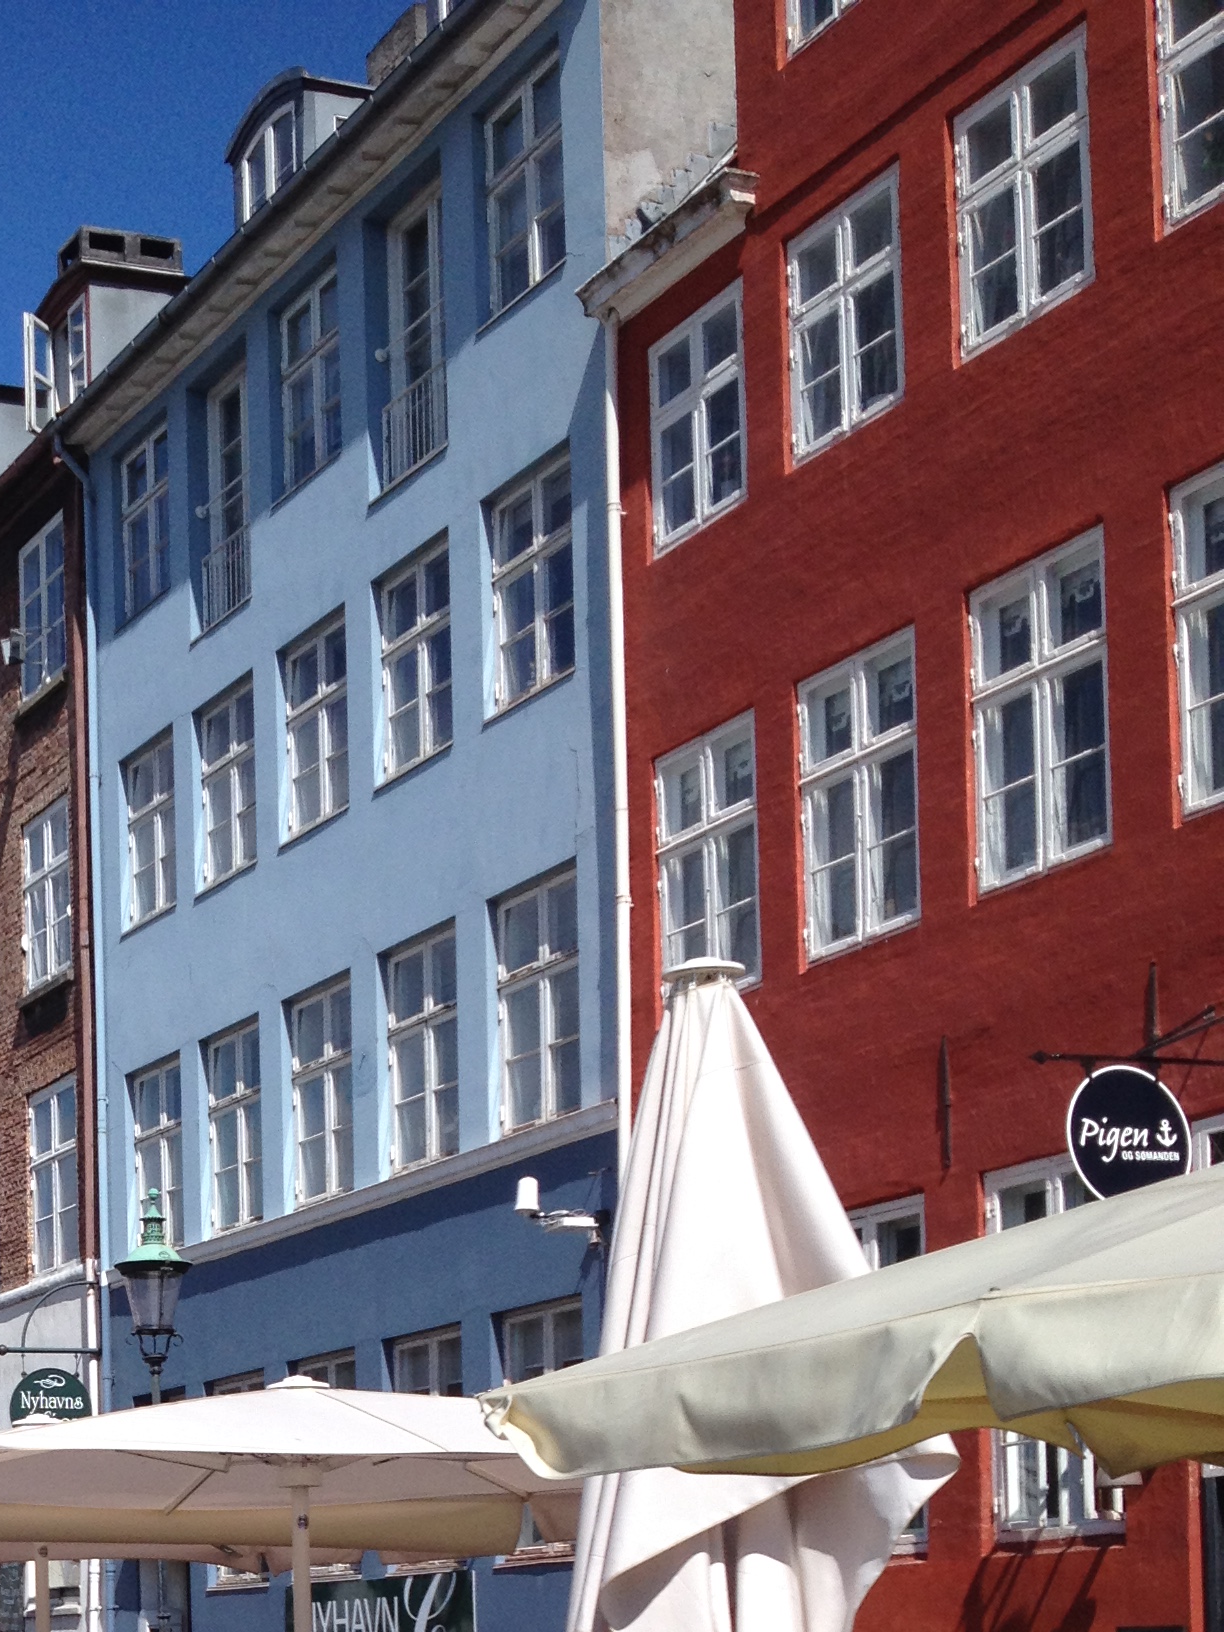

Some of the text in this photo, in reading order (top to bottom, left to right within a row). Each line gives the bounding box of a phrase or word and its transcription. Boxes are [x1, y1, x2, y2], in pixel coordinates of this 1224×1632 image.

[1080, 1117, 1149, 1163] Pigen
[1122, 1151, 1133, 1160] OG
[20, 1390, 84, 1415] Nyhavns
